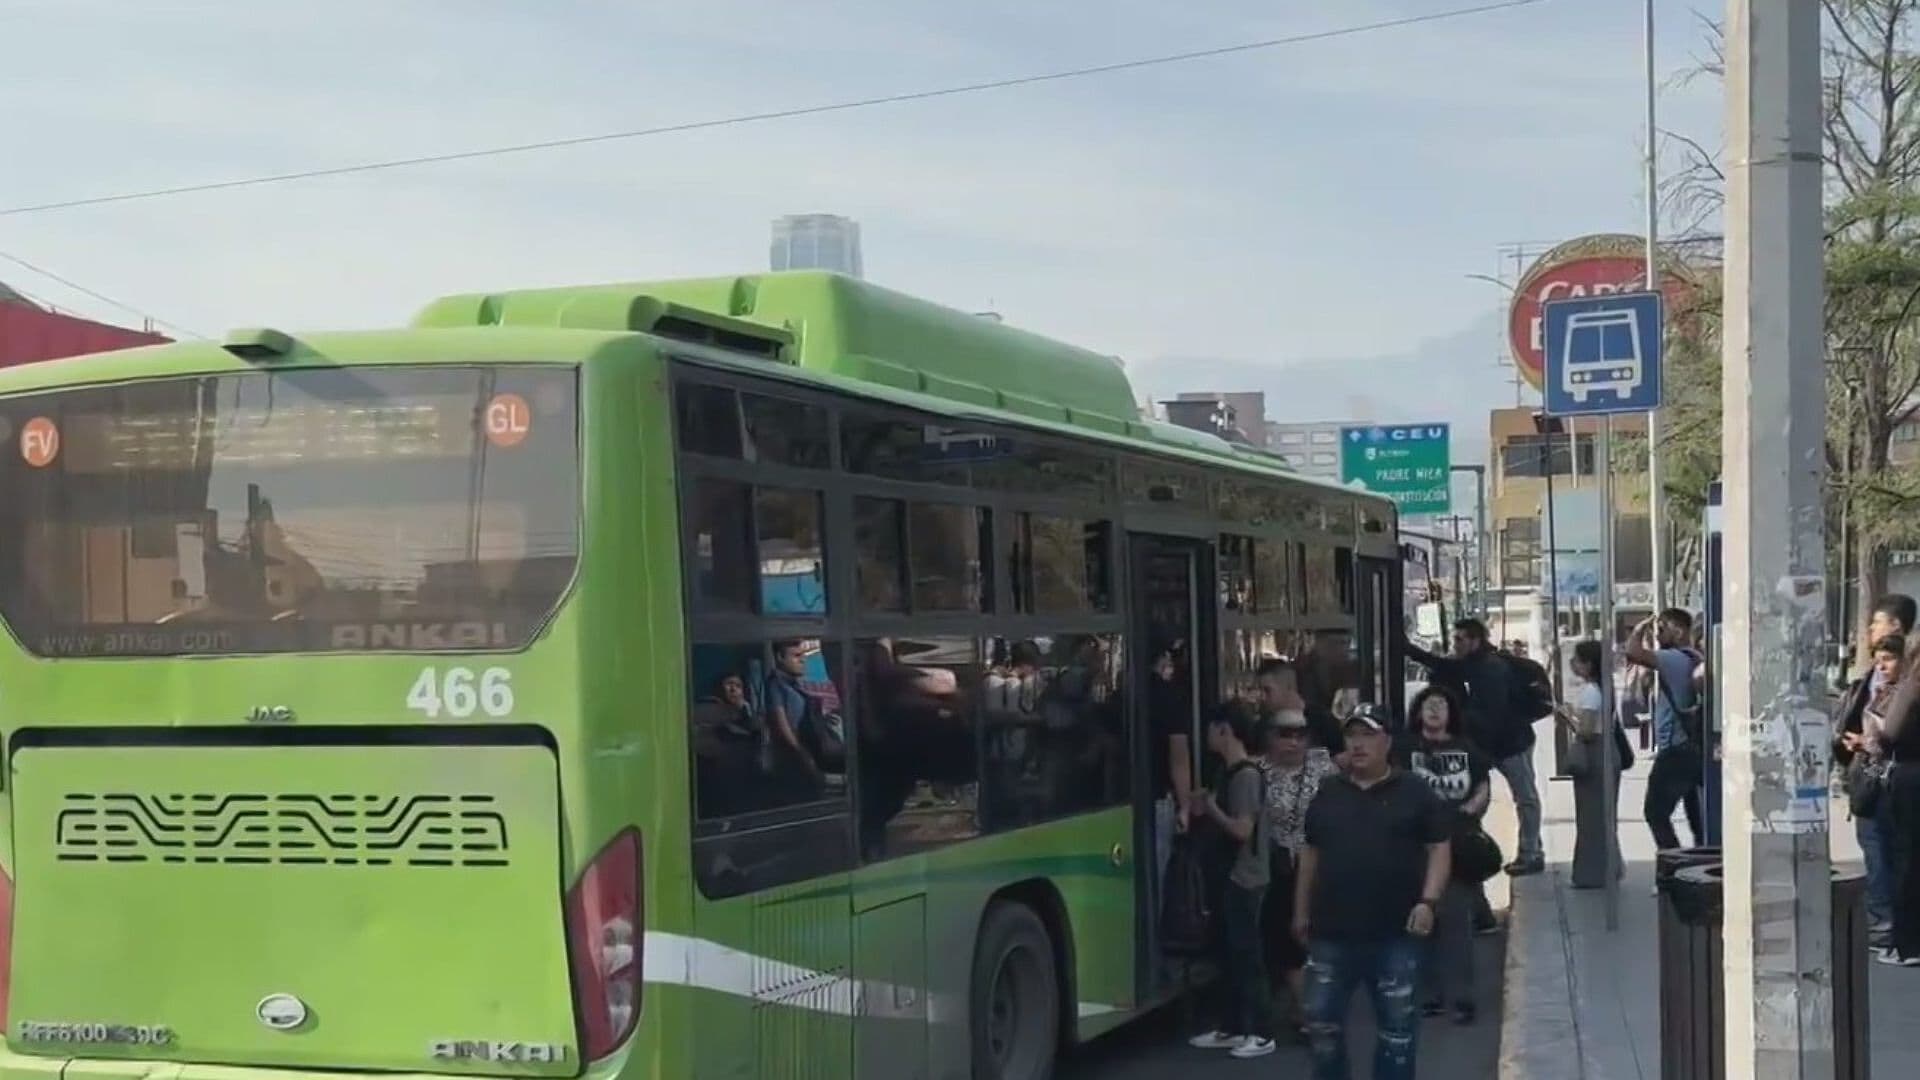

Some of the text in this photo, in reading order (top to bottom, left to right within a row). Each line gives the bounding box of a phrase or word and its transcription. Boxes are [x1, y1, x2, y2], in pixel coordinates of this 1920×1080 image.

[487, 403, 527, 433] GL
[22, 429, 54, 460] FV
[1391, 427, 1442, 440] CEU
[331, 623, 507, 648] ANKAI
[406, 666, 514, 718] 466
[430, 1041, 568, 1062] ANKAI
